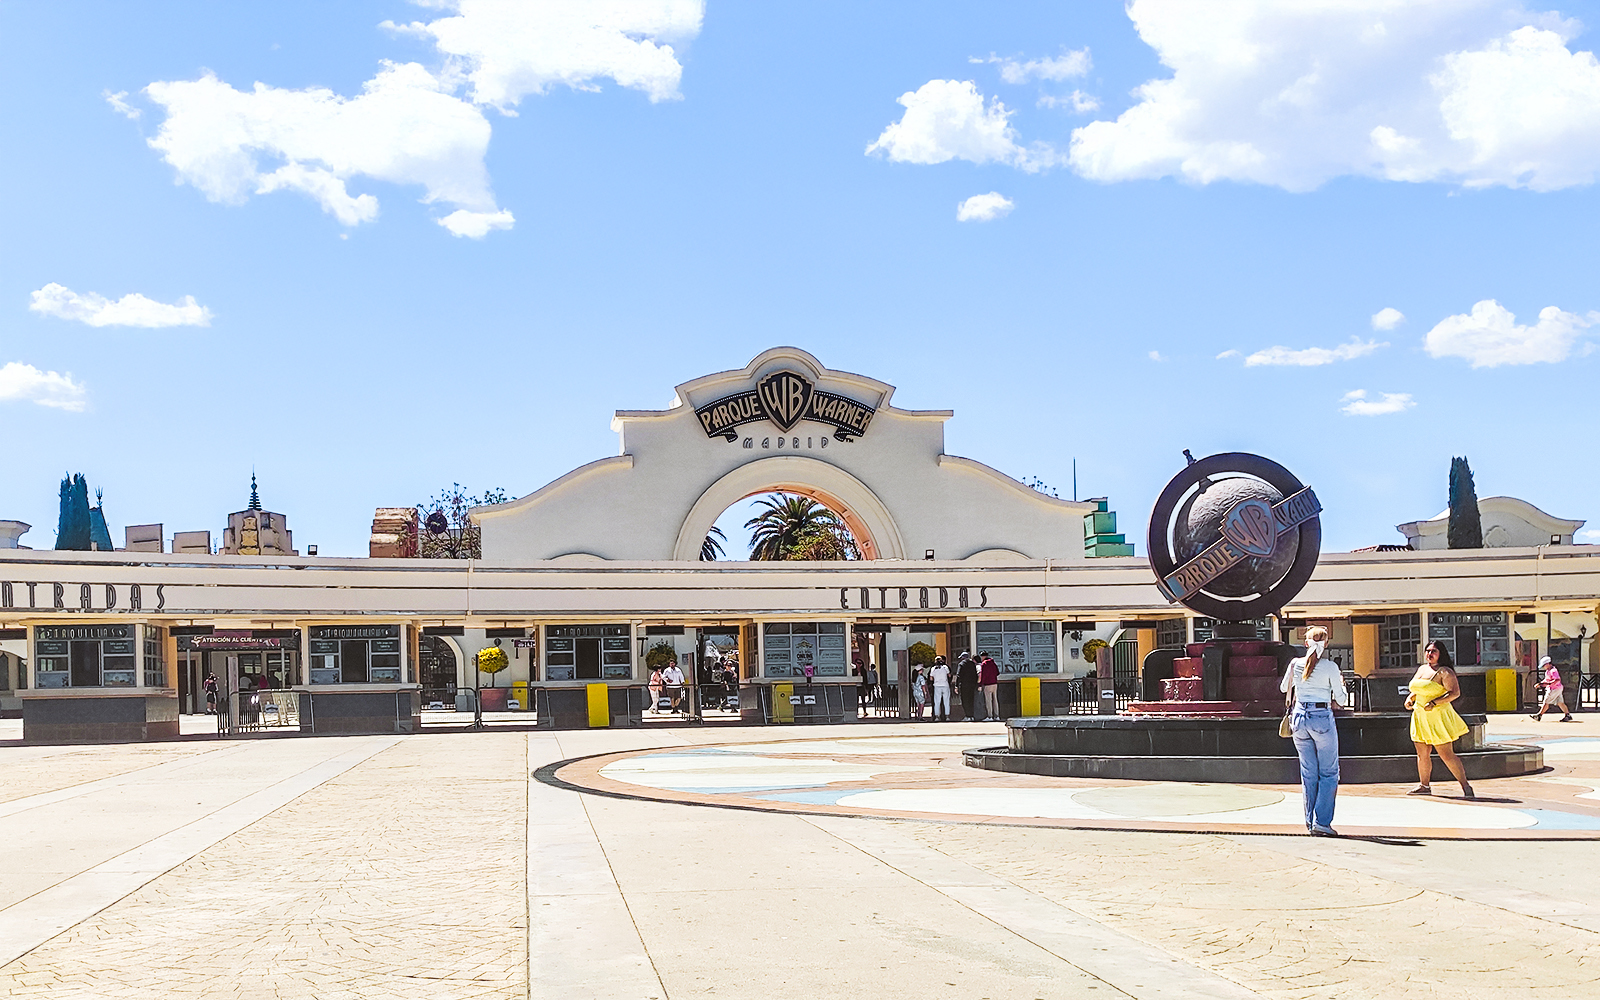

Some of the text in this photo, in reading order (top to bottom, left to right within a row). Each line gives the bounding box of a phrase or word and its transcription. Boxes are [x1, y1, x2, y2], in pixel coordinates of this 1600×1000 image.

[700, 394, 874, 432] PARQUE WARNER
[764, 376, 804, 424] WB
[742, 436, 830, 449] MADRID
[1176, 542, 1239, 592] PARQUE
[1227, 504, 1271, 553] WB
[1, 580, 166, 610] NTRADAS
[840, 586, 989, 610] ENTRADAS
[202, 635, 231, 643] ATENCIÓN
